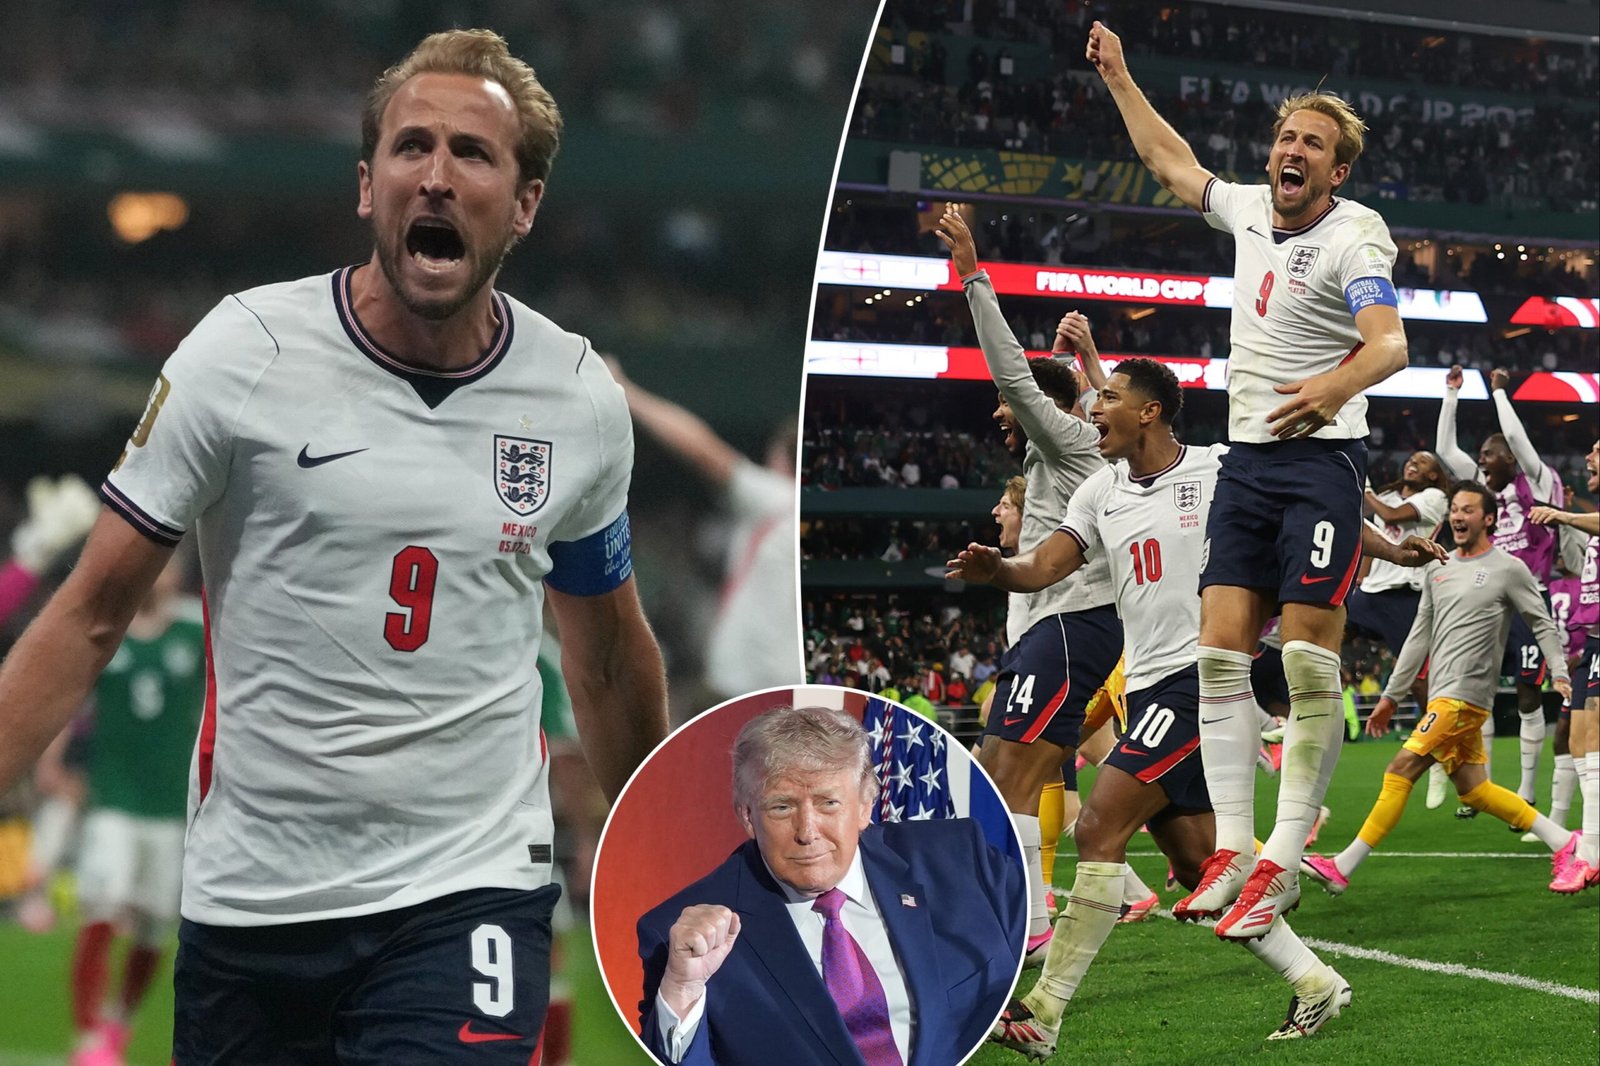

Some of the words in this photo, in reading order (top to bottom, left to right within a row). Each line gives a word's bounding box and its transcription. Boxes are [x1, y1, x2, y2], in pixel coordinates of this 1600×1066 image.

[1036, 271, 1084, 293] FIFA
[1083, 274, 1160, 298] WORLD
[1160, 279, 1203, 301] CUP
[1256, 271, 1275, 318] 9
[1350, 285, 1381, 300] UNITES
[502, 522, 538, 538] MEXICO
[1179, 514, 1199, 522] MEXICO
[1130, 538, 1162, 586] 10
[1310, 520, 1335, 569] 9
[384, 545, 439, 652] 9
[1521, 644, 1539, 670] 12
[1006, 673, 1037, 714] 24
[1130, 703, 1176, 749] 10
[471, 923, 514, 1018] 9
